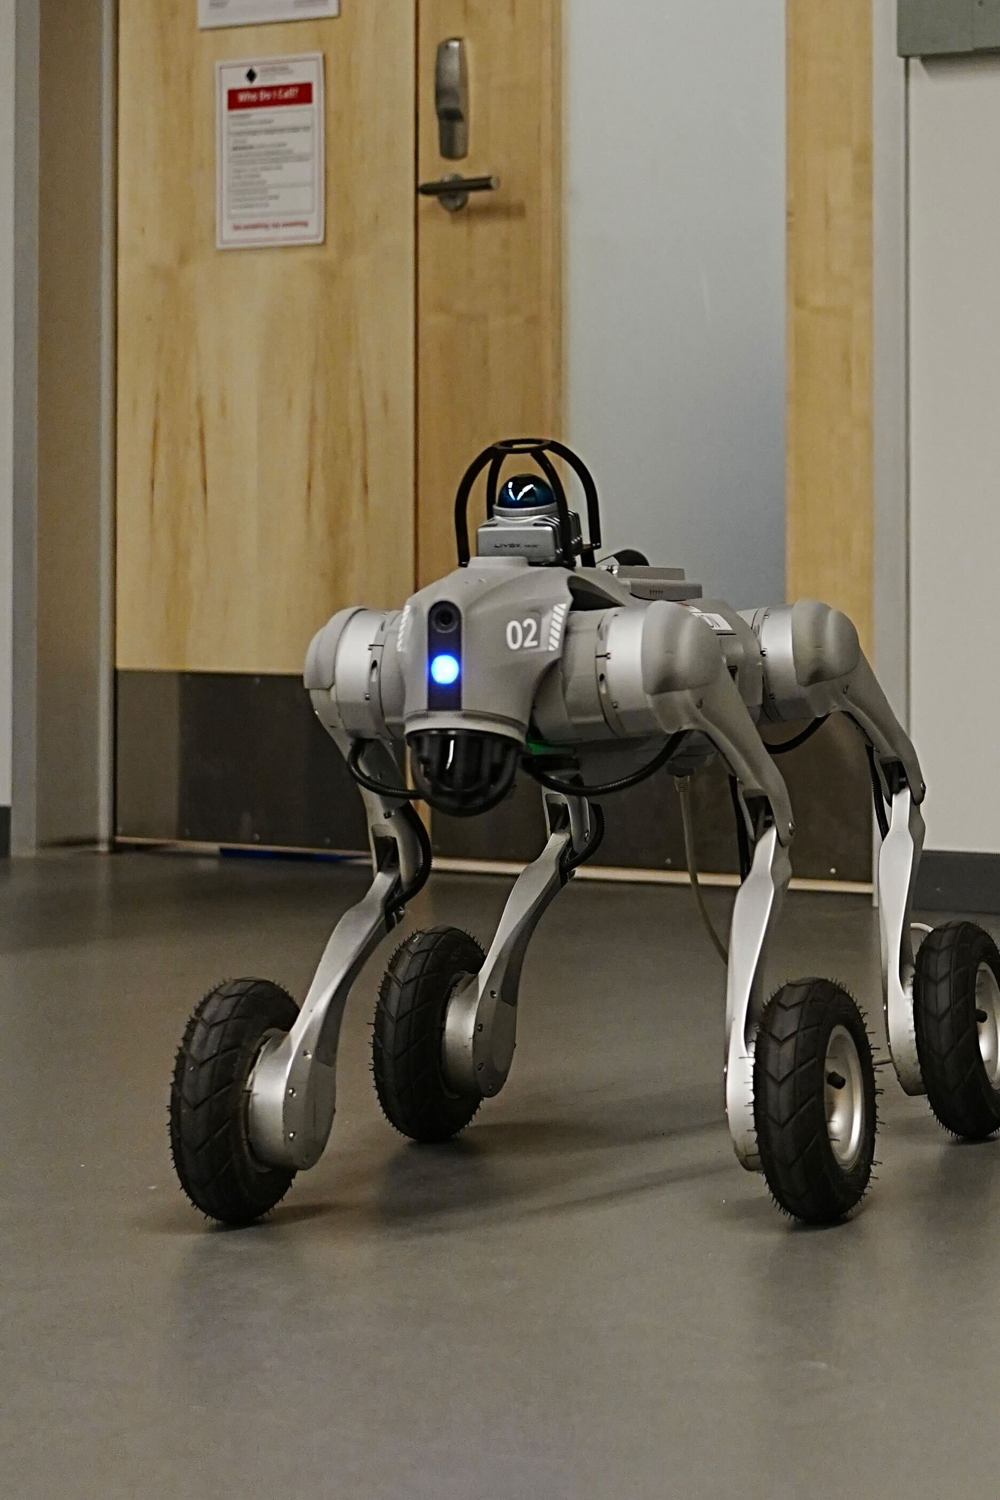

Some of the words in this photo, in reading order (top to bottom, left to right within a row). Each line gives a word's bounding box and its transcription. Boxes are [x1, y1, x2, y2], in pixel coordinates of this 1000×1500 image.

[237, 91, 257, 103] Who
[258, 89, 271, 101] Do
[506, 618, 538, 650] 02
